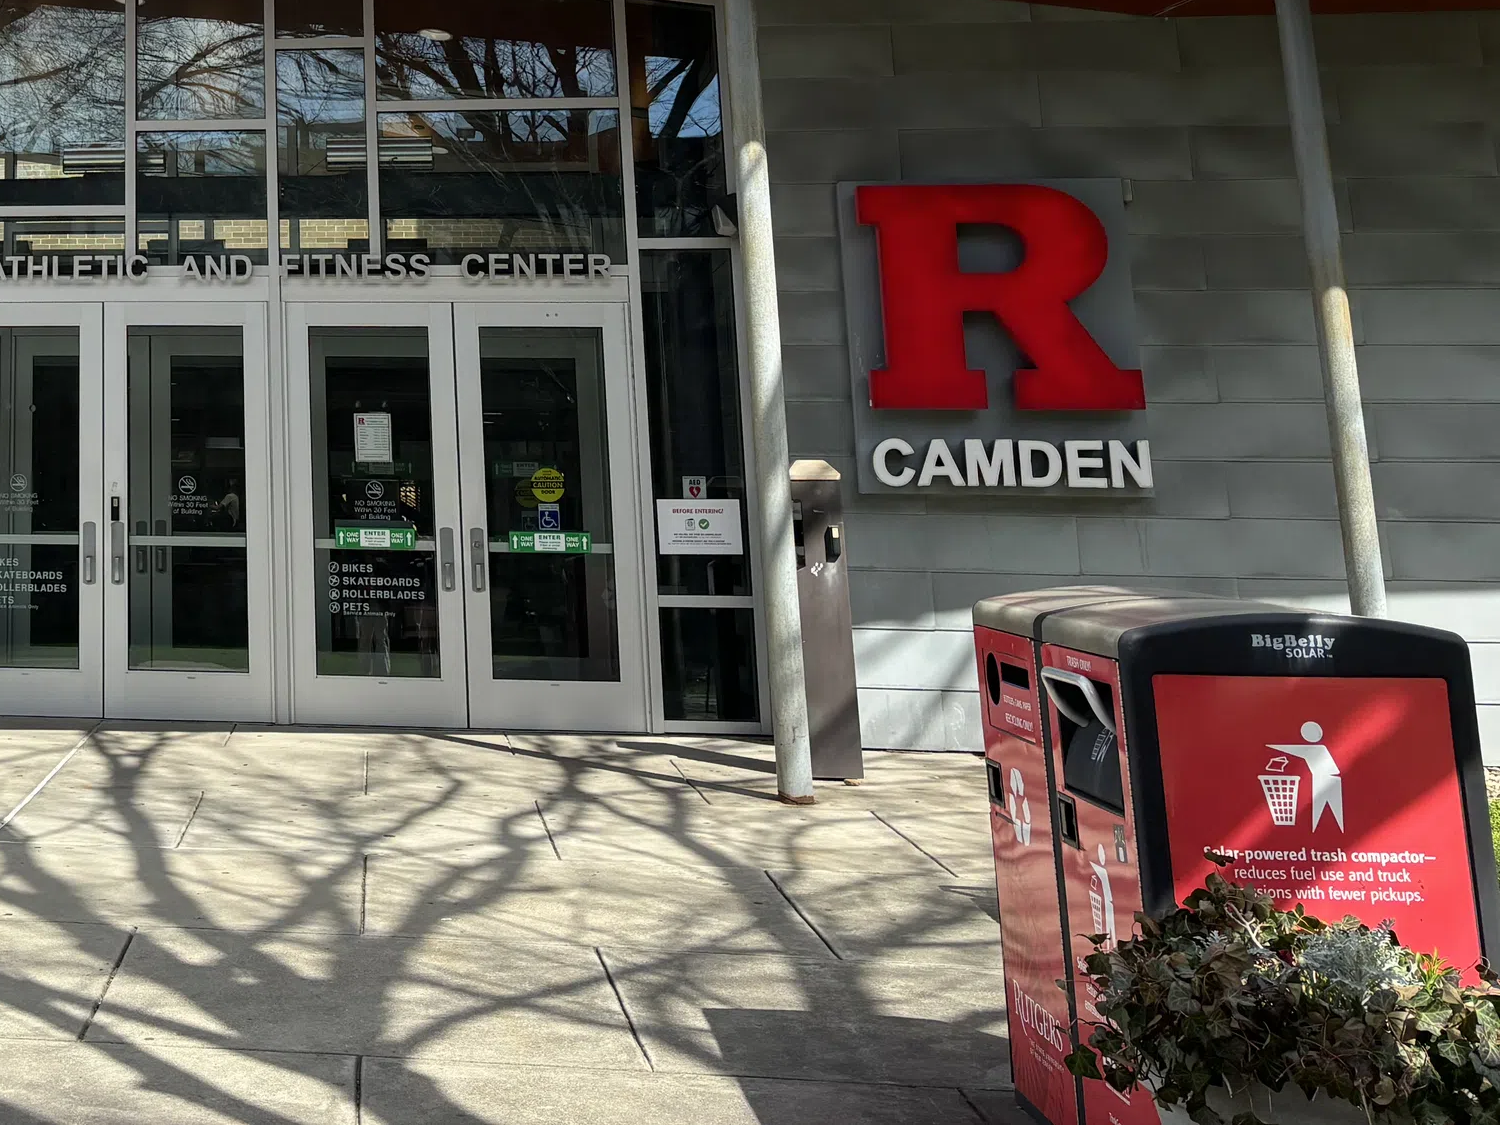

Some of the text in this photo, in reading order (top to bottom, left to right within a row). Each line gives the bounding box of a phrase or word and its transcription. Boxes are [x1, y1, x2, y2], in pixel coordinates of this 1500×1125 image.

[181, 255, 253, 282] AND
[280, 253, 431, 280] FITNESS
[460, 253, 612, 280] CENTER
[855, 184, 1146, 410] R
[872, 437, 1154, 489] CAMDEN
[342, 564, 373, 573] BIKES
[343, 577, 420, 587] SKATEBOARDS
[343, 590, 425, 600] ROLLERBLADES
[343, 603, 370, 611] PETS
[1251, 634, 1335, 650] BigBelly
[1286, 648, 1325, 658] SOLAR
[1311, 848, 1347, 862] trash
[1234, 865, 1411, 882] reduces fuel use and truck
[1296, 886, 1325, 900] with
[1329, 886, 1366, 901] fewer
[1371, 887, 1424, 905] pickups.
[1013, 978, 1063, 1052] RUTGERS
